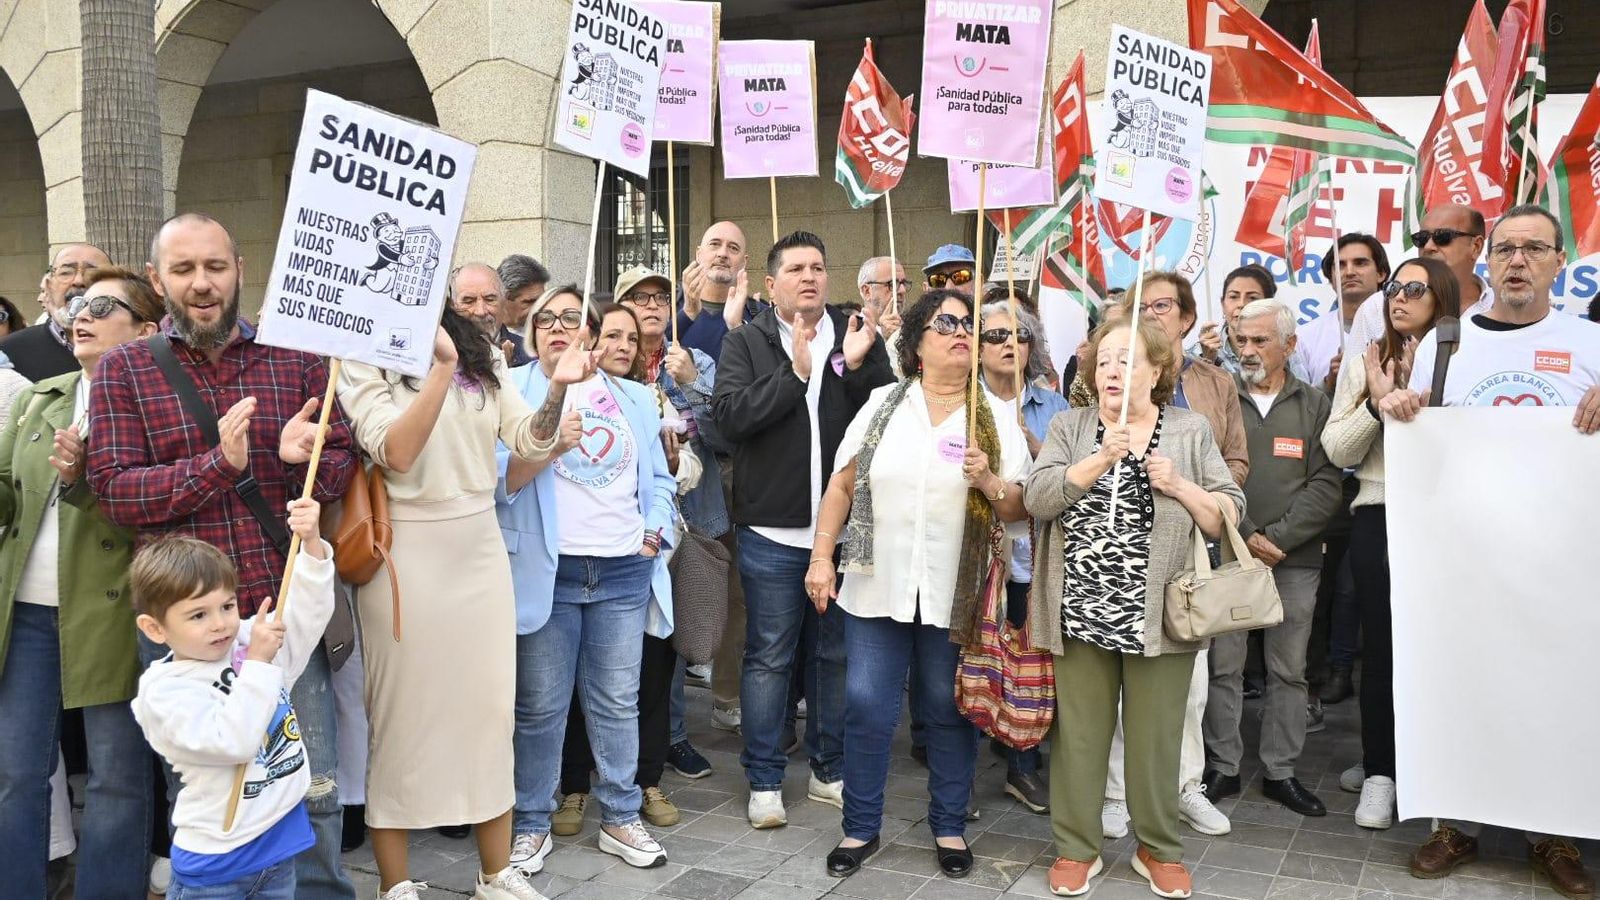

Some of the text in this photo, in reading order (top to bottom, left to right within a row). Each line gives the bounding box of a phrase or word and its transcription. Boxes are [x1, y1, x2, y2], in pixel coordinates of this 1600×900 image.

[934, 1, 1042, 24] PRIVATIZAR
[574, 12, 658, 67] PÚBLICA
[667, 39, 684, 53] TA
[955, 22, 1011, 45] MATA
[1116, 33, 1206, 80] SANIDAD
[666, 86, 697, 97] Pública
[744, 78, 787, 92] MATA
[936, 86, 1023, 105] ¡Sanidad Pública
[1113, 59, 1205, 107] PÚBLICA
[659, 96, 686, 104] todas!
[947, 100, 1008, 115] para todas!
[734, 124, 801, 136] ¡Sanidad Pública
[745, 132, 791, 144] para todas!
[318, 114, 457, 180] SANIDAD
[853, 135, 906, 177] Huelva
[1432, 126, 1473, 206] Huelva
[309, 149, 446, 216] PÚBLICA
[297, 207, 370, 243] NUESTRAS
[294, 229, 335, 256] VIDAS
[287, 251, 360, 287] IMPORTAN
[282, 274, 345, 306] MÁS QUE
[277, 297, 375, 336] SUS NEGOCIOS
[1472, 373, 1556, 400] MAREA BLANCA
[585, 410, 621, 430] BLANCA
[570, 475, 610, 487] HUELVA
